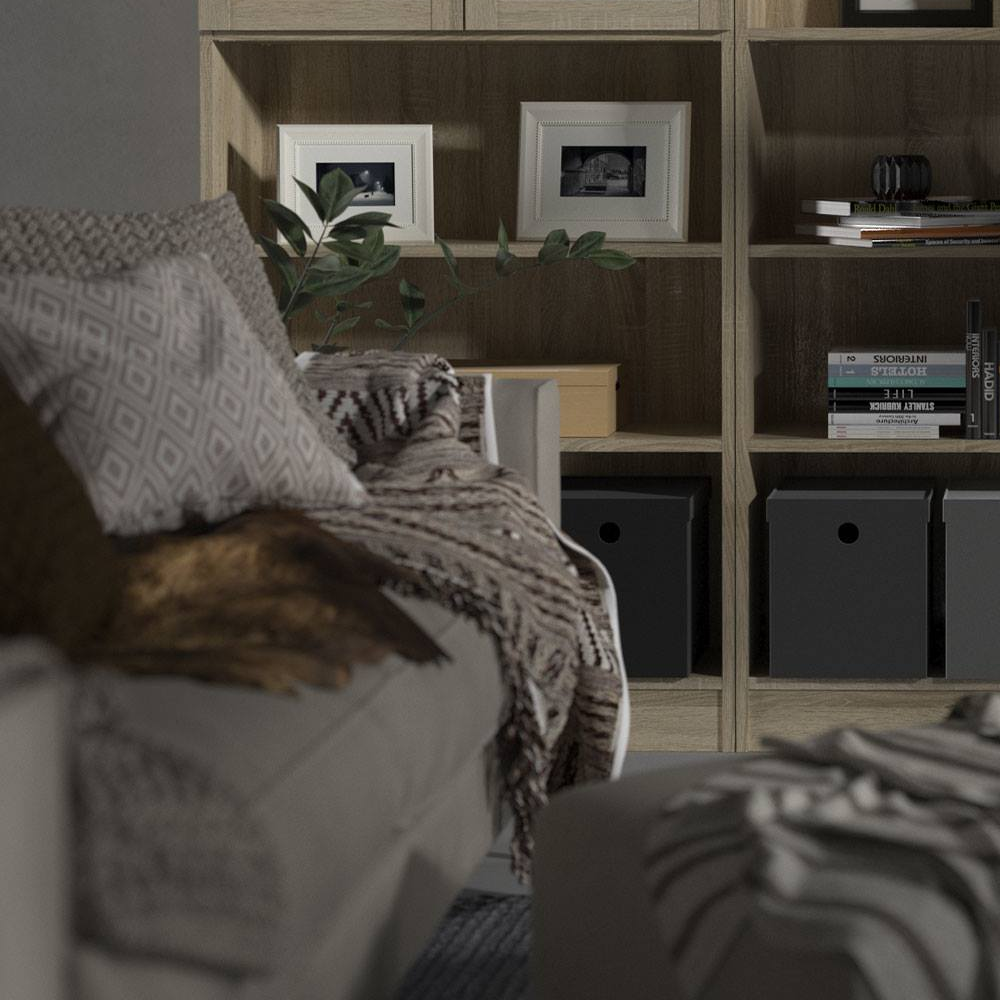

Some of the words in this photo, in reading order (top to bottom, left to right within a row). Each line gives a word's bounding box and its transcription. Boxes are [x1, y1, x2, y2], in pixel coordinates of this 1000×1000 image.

[879, 203, 897, 214] Dahl
[873, 355, 927, 363] INTERIORS
[971, 333, 980, 379] INTERIORS
[871, 366, 928, 376] HOTELS
[984, 362, 995, 402] HADID
[883, 389, 914, 399] LIFE
[869, 401, 902, 411] KUBRICK
[903, 401, 935, 411] STANLEY
[970, 413, 975, 422] 1
